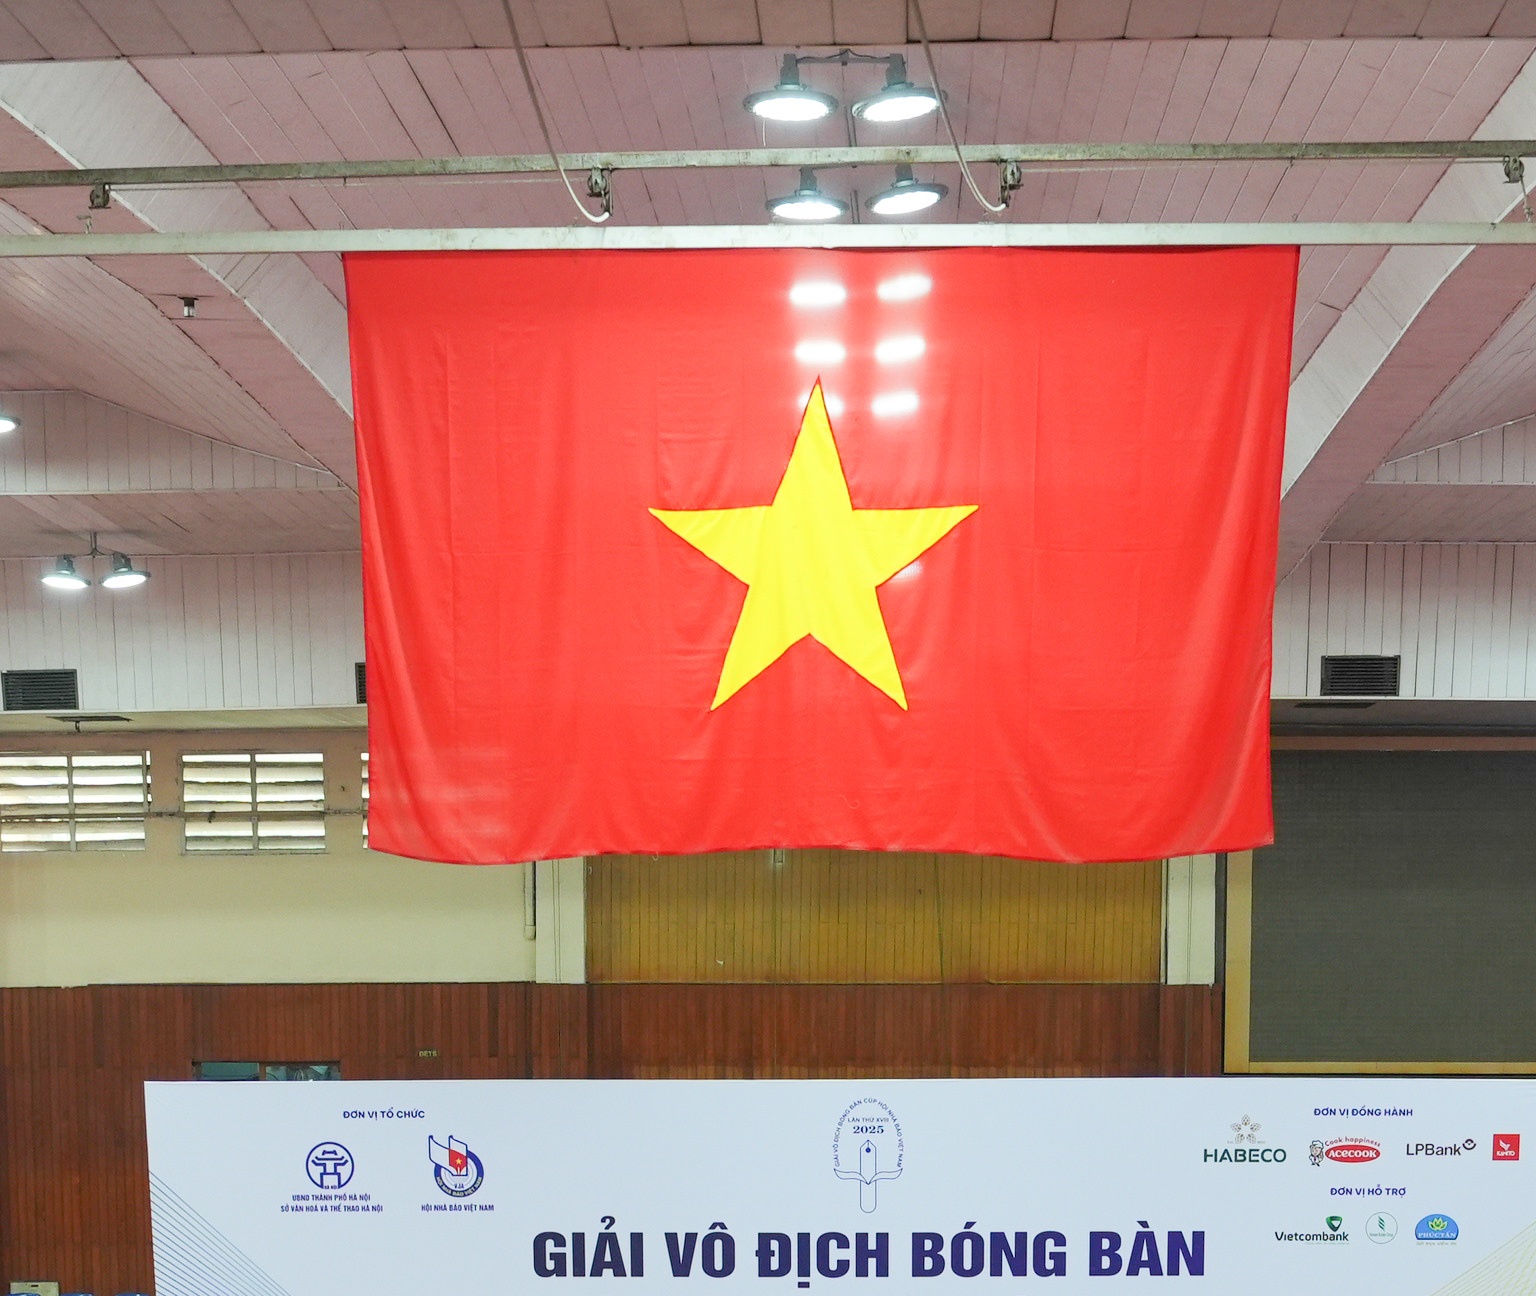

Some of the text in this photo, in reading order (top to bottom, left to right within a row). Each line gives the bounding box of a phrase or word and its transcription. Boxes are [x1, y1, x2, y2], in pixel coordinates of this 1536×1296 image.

[343, 1107, 425, 1121] ĐƠN VỊ TỔ CHỨC
[1314, 1105, 1413, 1120] ĐƠN VỊ ĐỒNG HÀNH
[853, 1125, 884, 1134] 2025
[1325, 1136, 1380, 1147] Cook happiness
[1406, 1142, 1461, 1156] LPBank
[1204, 1149, 1286, 1162] HABECO
[312, 1193, 332, 1201] THÀNH
[1330, 1187, 1352, 1196] ĐƠN
[1355, 1188, 1365, 1198] VỊ
[1385, 1187, 1406, 1198] TRỢ
[361, 1204, 370, 1212] HÀ
[422, 1203, 432, 1212] HỘI
[449, 1203, 462, 1211] BÁO
[464, 1203, 477, 1212] VIỆT
[1275, 1232, 1349, 1241] Vietcombank
[533, 1215, 1205, 1288] GIẢI VÔ ĐỊCH BÓNG BÀN
